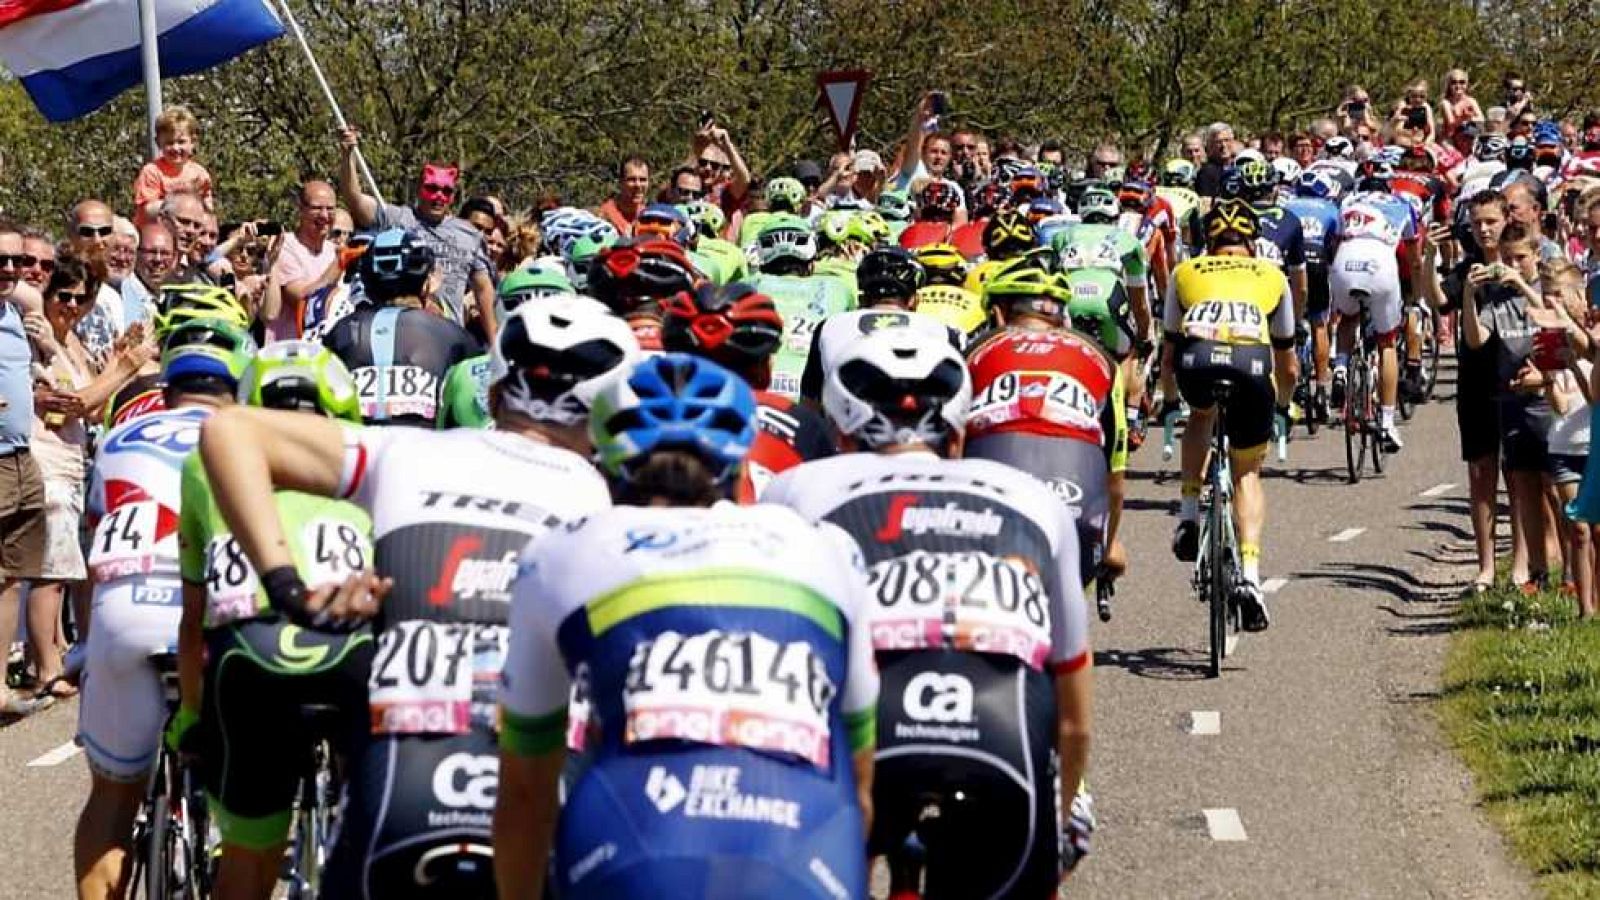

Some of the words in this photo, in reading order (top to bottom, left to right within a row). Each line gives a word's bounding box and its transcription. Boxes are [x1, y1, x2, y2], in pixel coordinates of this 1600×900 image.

[1228, 302, 1261, 325] 179
[386, 368, 432, 398] 182
[970, 374, 1016, 412] 19
[102, 506, 142, 552] 74
[205, 537, 249, 593] 48
[315, 523, 365, 572] 48
[134, 586, 174, 603] FDJ
[960, 553, 1045, 628] 208
[373, 623, 471, 689] 207
[902, 671, 973, 723] ca
[684, 791, 800, 829] EXCHANGE
